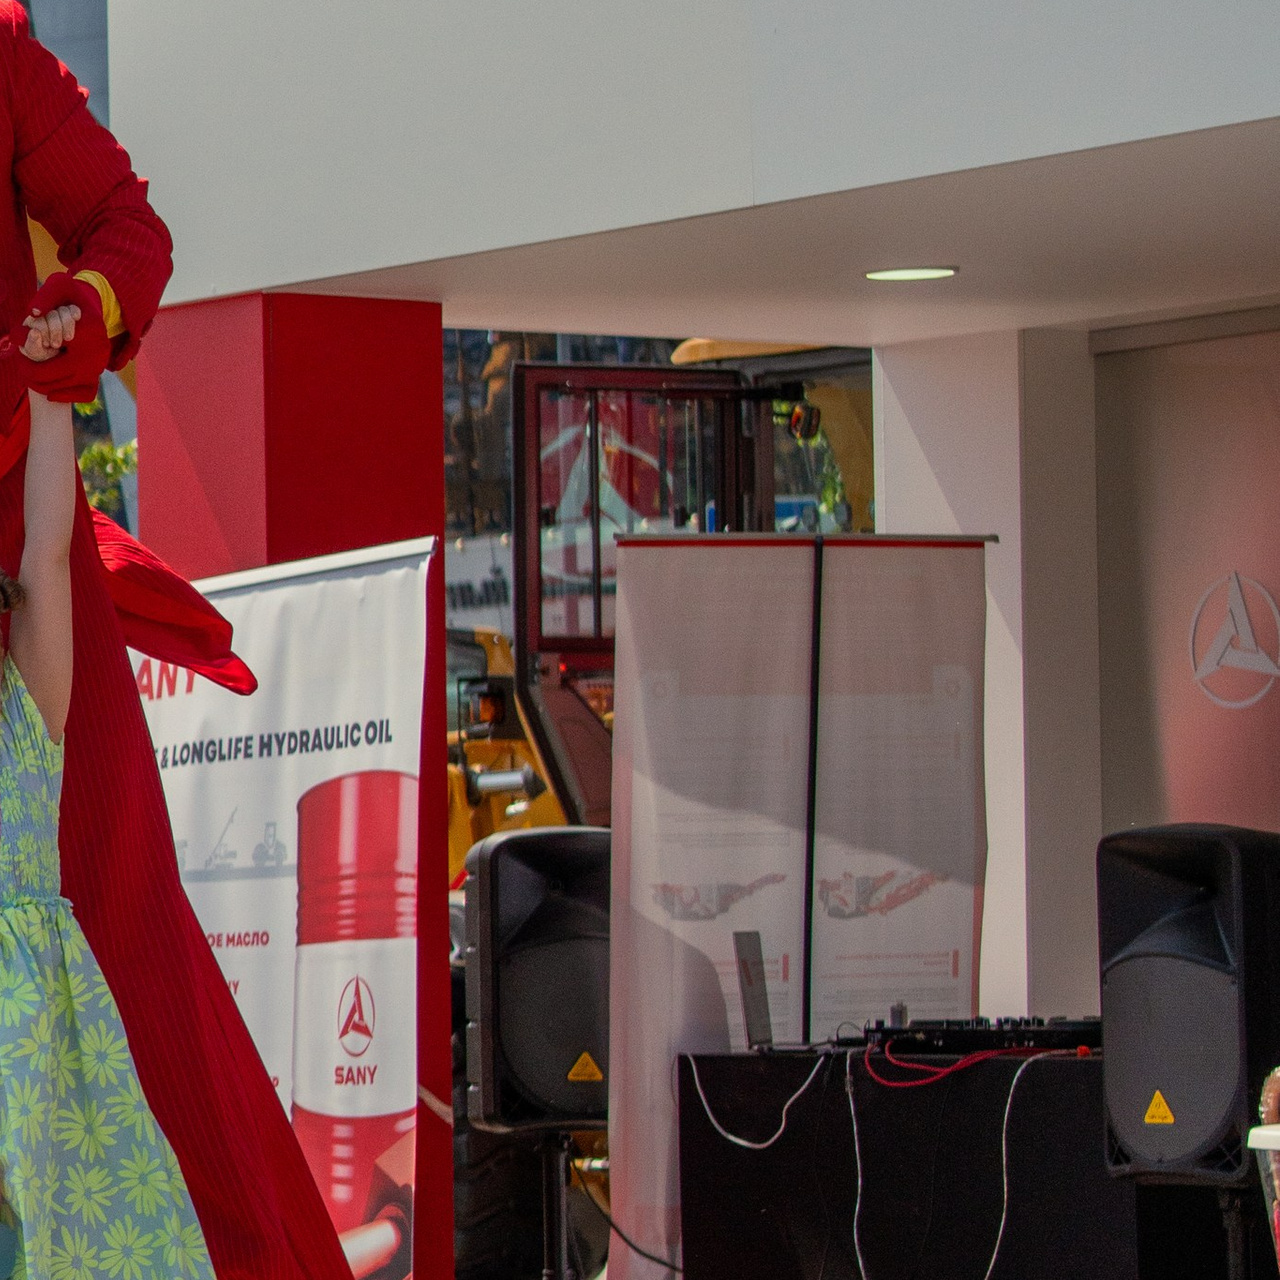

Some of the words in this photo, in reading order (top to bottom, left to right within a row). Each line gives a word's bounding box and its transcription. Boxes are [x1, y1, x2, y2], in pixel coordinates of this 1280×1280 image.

[136, 658, 196, 701] ANY
[161, 746, 169, 769] &
[171, 735, 253, 767] LONGLIFE
[258, 722, 362, 758] HYDRAULIC
[364, 718, 393, 745] OIL
[226, 930, 270, 948] МАСЛО
[334, 1065, 378, 1086] SANY
